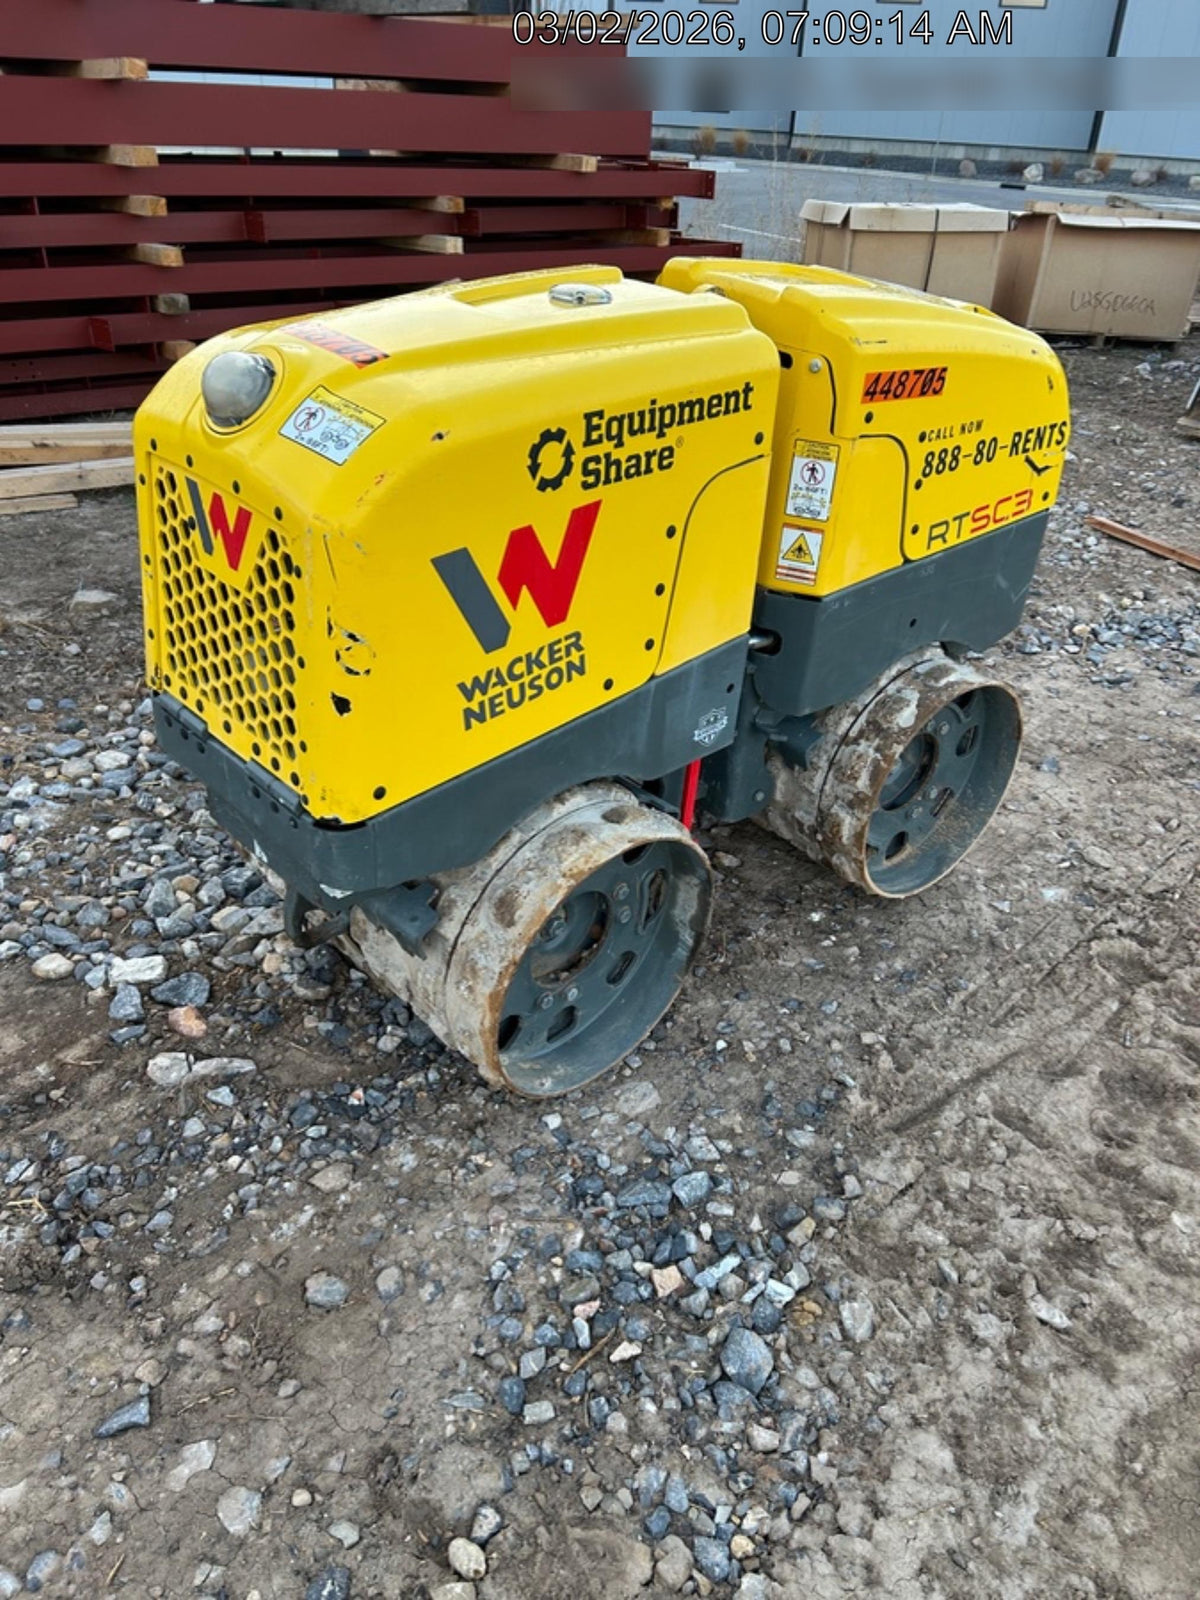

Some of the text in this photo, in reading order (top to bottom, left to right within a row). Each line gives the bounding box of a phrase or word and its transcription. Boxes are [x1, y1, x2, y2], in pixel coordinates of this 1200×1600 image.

[864, 367, 948, 401] 448705
[582, 381, 754, 448] Equipment
[927, 419, 984, 442] CALL NOW
[580, 445, 675, 491] Share
[921, 420, 1068, 479] 888-80-RENTS
[456, 630, 585, 703] WACKER
[462, 653, 586, 731] NEUSON
